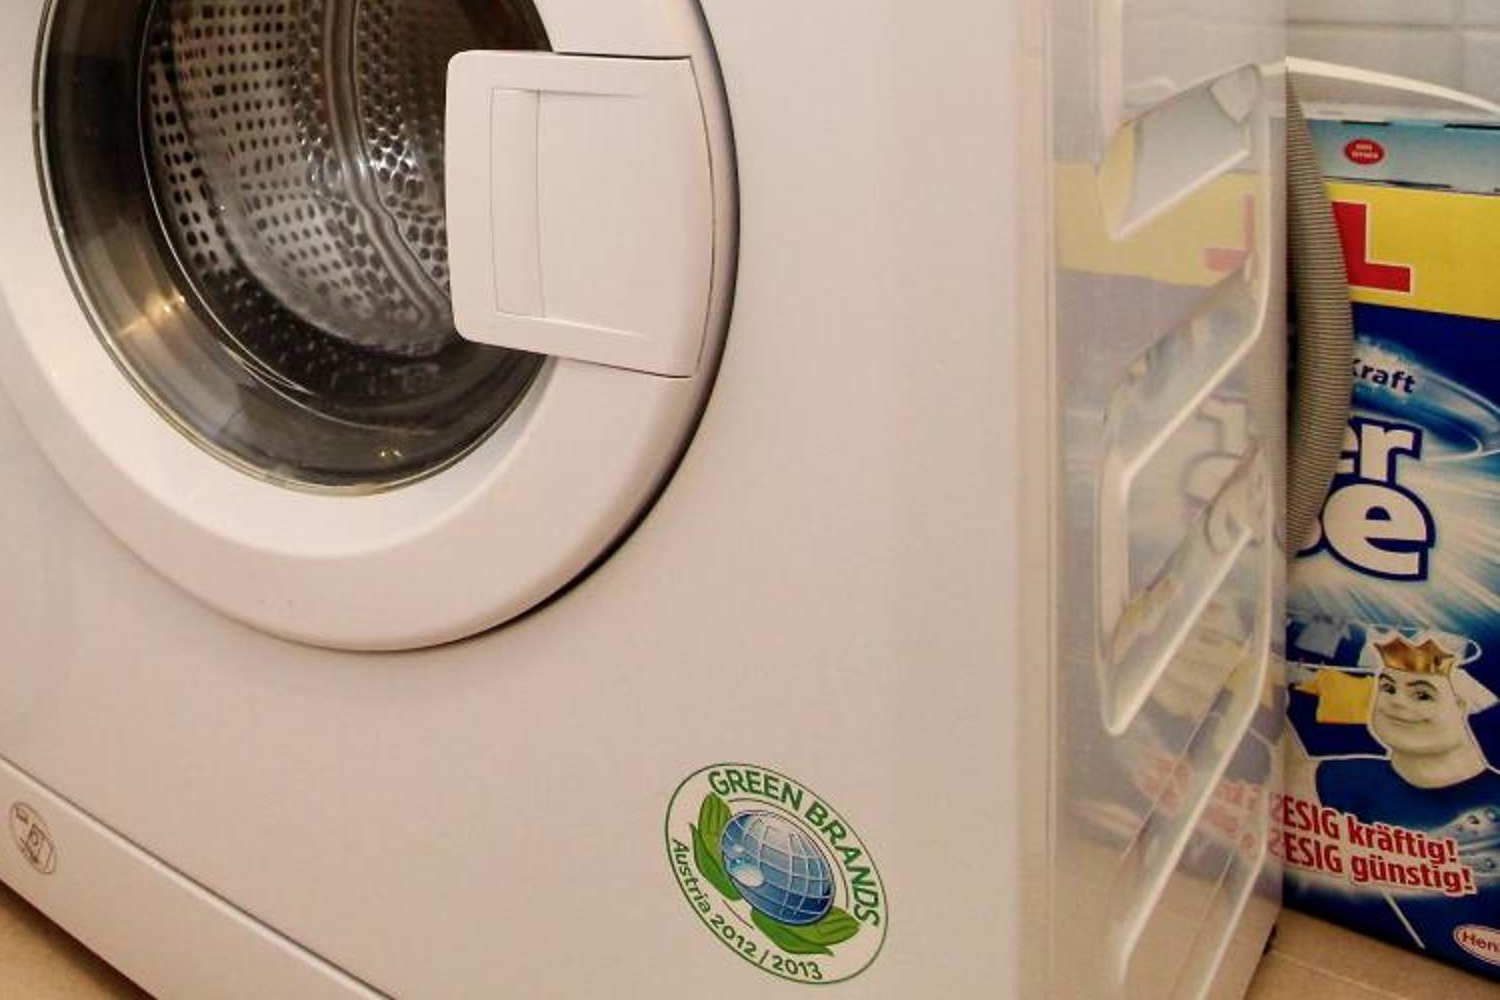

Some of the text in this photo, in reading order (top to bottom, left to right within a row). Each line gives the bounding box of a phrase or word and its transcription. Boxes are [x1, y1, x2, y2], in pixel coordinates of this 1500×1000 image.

[706, 768, 881, 928] GREEN BRANDS
[1346, 814, 1457, 865] kräftig!
[1350, 854, 1473, 893] günstig!
[671, 837, 712, 914] Austria
[710, 914, 757, 957] 2012
[772, 954, 823, 980] 2013
